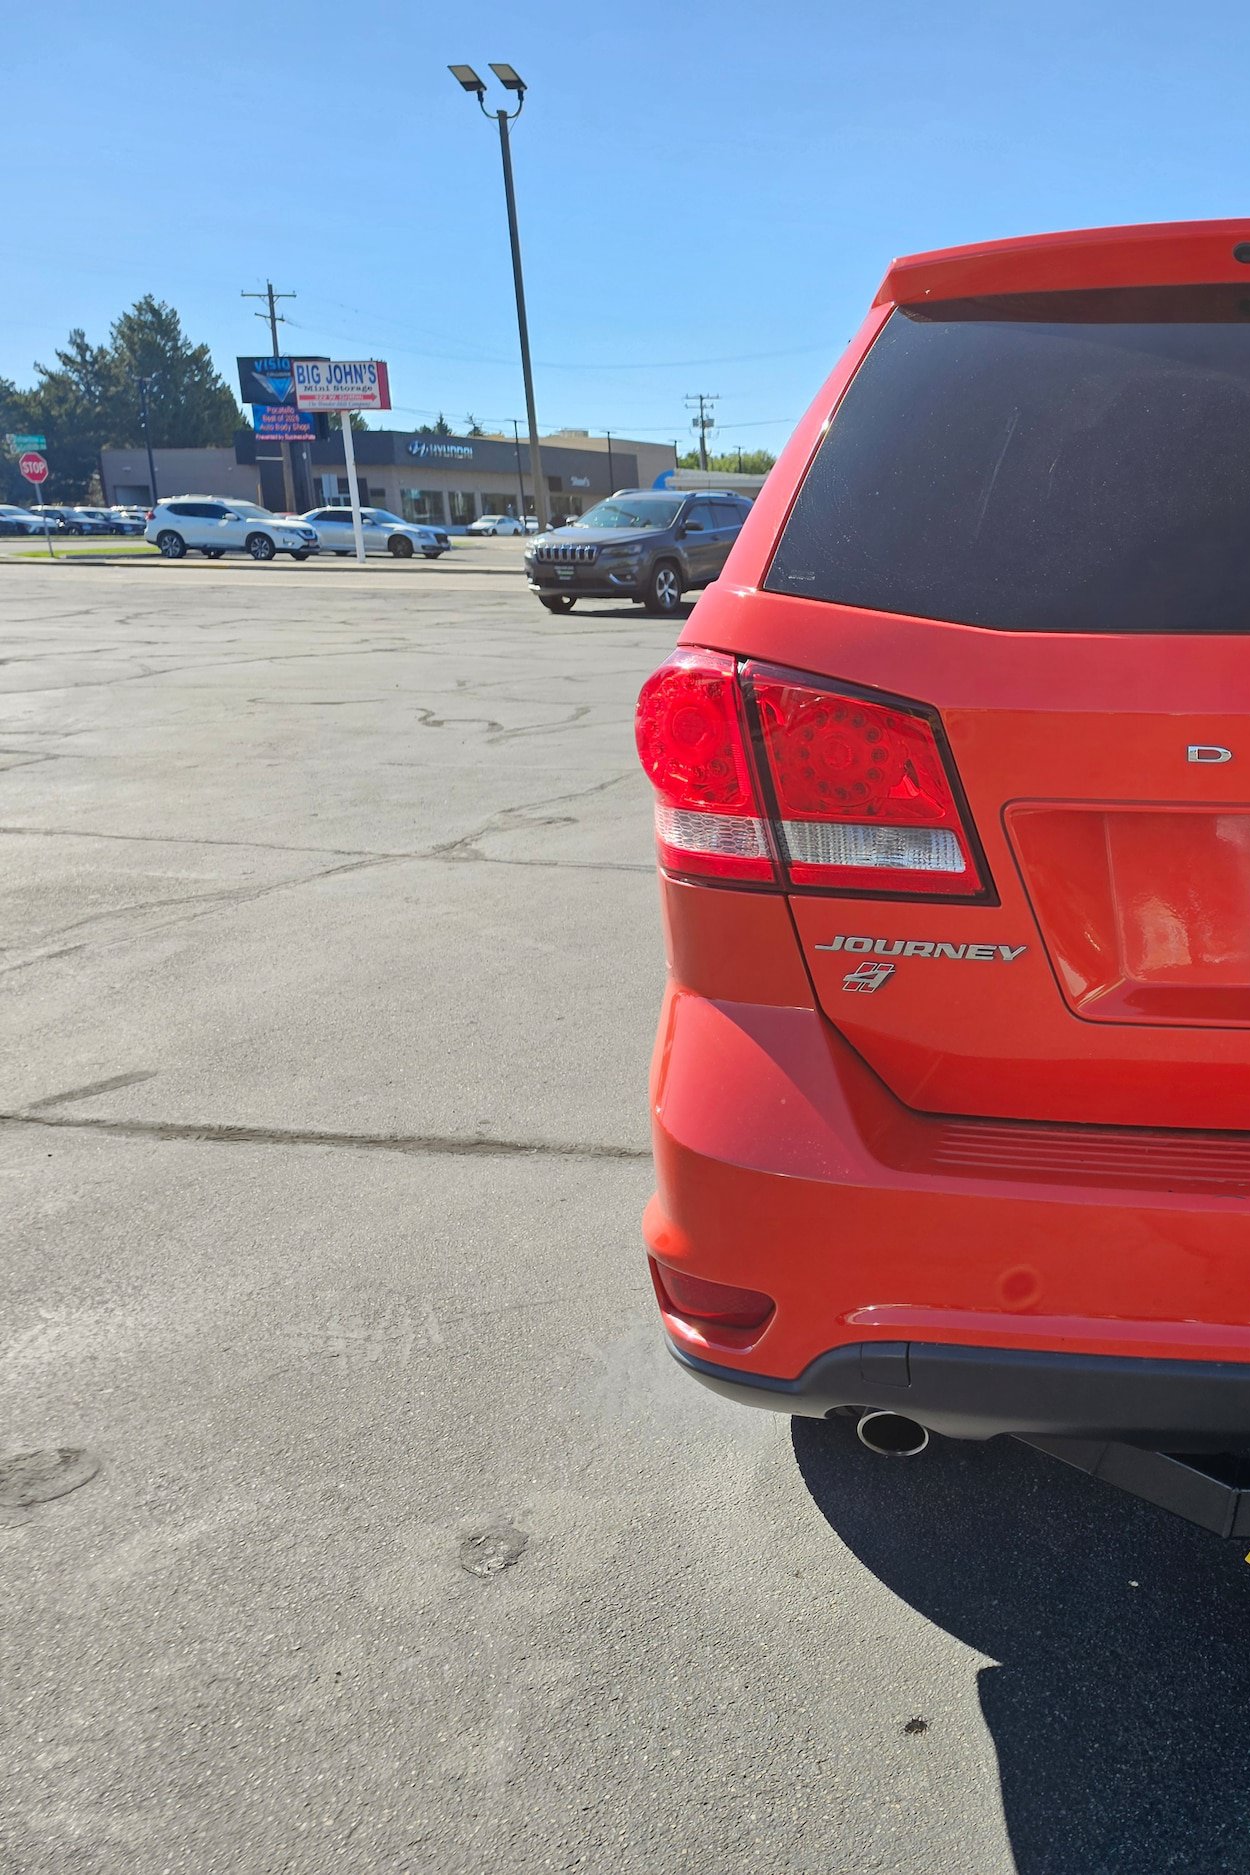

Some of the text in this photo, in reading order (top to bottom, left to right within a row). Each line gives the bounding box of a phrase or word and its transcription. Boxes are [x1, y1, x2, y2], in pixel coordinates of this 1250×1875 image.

[296, 363, 376, 384] BIG JOHN'S
[333, 385, 373, 393] Storage
[429, 443, 473, 459] HYUNDAI
[22, 461, 45, 474] STOP
[814, 935, 1027, 961] JOURNEY
